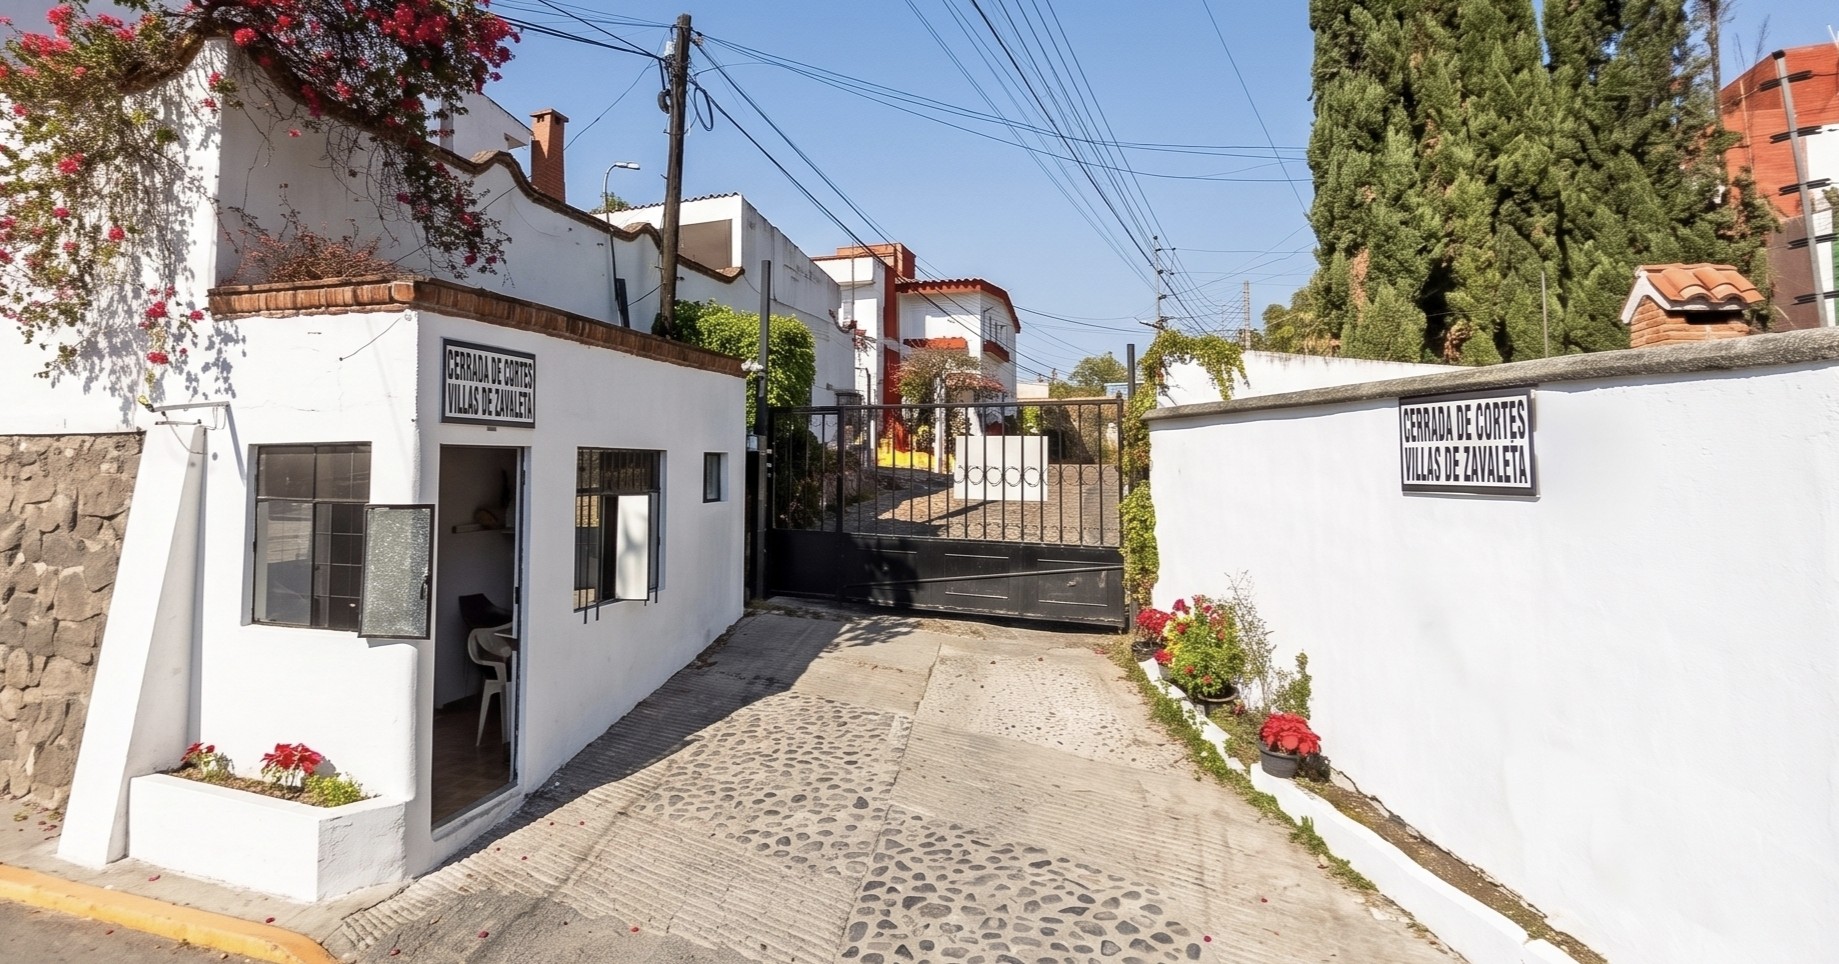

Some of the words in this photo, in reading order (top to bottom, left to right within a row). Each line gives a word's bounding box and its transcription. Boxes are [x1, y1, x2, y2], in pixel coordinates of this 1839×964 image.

[447, 349, 489, 383] CERRADA
[491, 356, 502, 385] DE
[504, 358, 533, 389] CORTES
[448, 382, 479, 415] VILLAS
[481, 386, 493, 416] DE
[495, 388, 533, 419] ZAVALETA
[1403, 405, 1453, 443] CERRADA
[1456, 404, 1472, 441] DE
[1475, 399, 1526, 441] CORTES
[1404, 446, 1441, 482] VILLAS
[1445, 445, 1460, 482] DE
[1463, 445, 1528, 484] ZAVALETA
